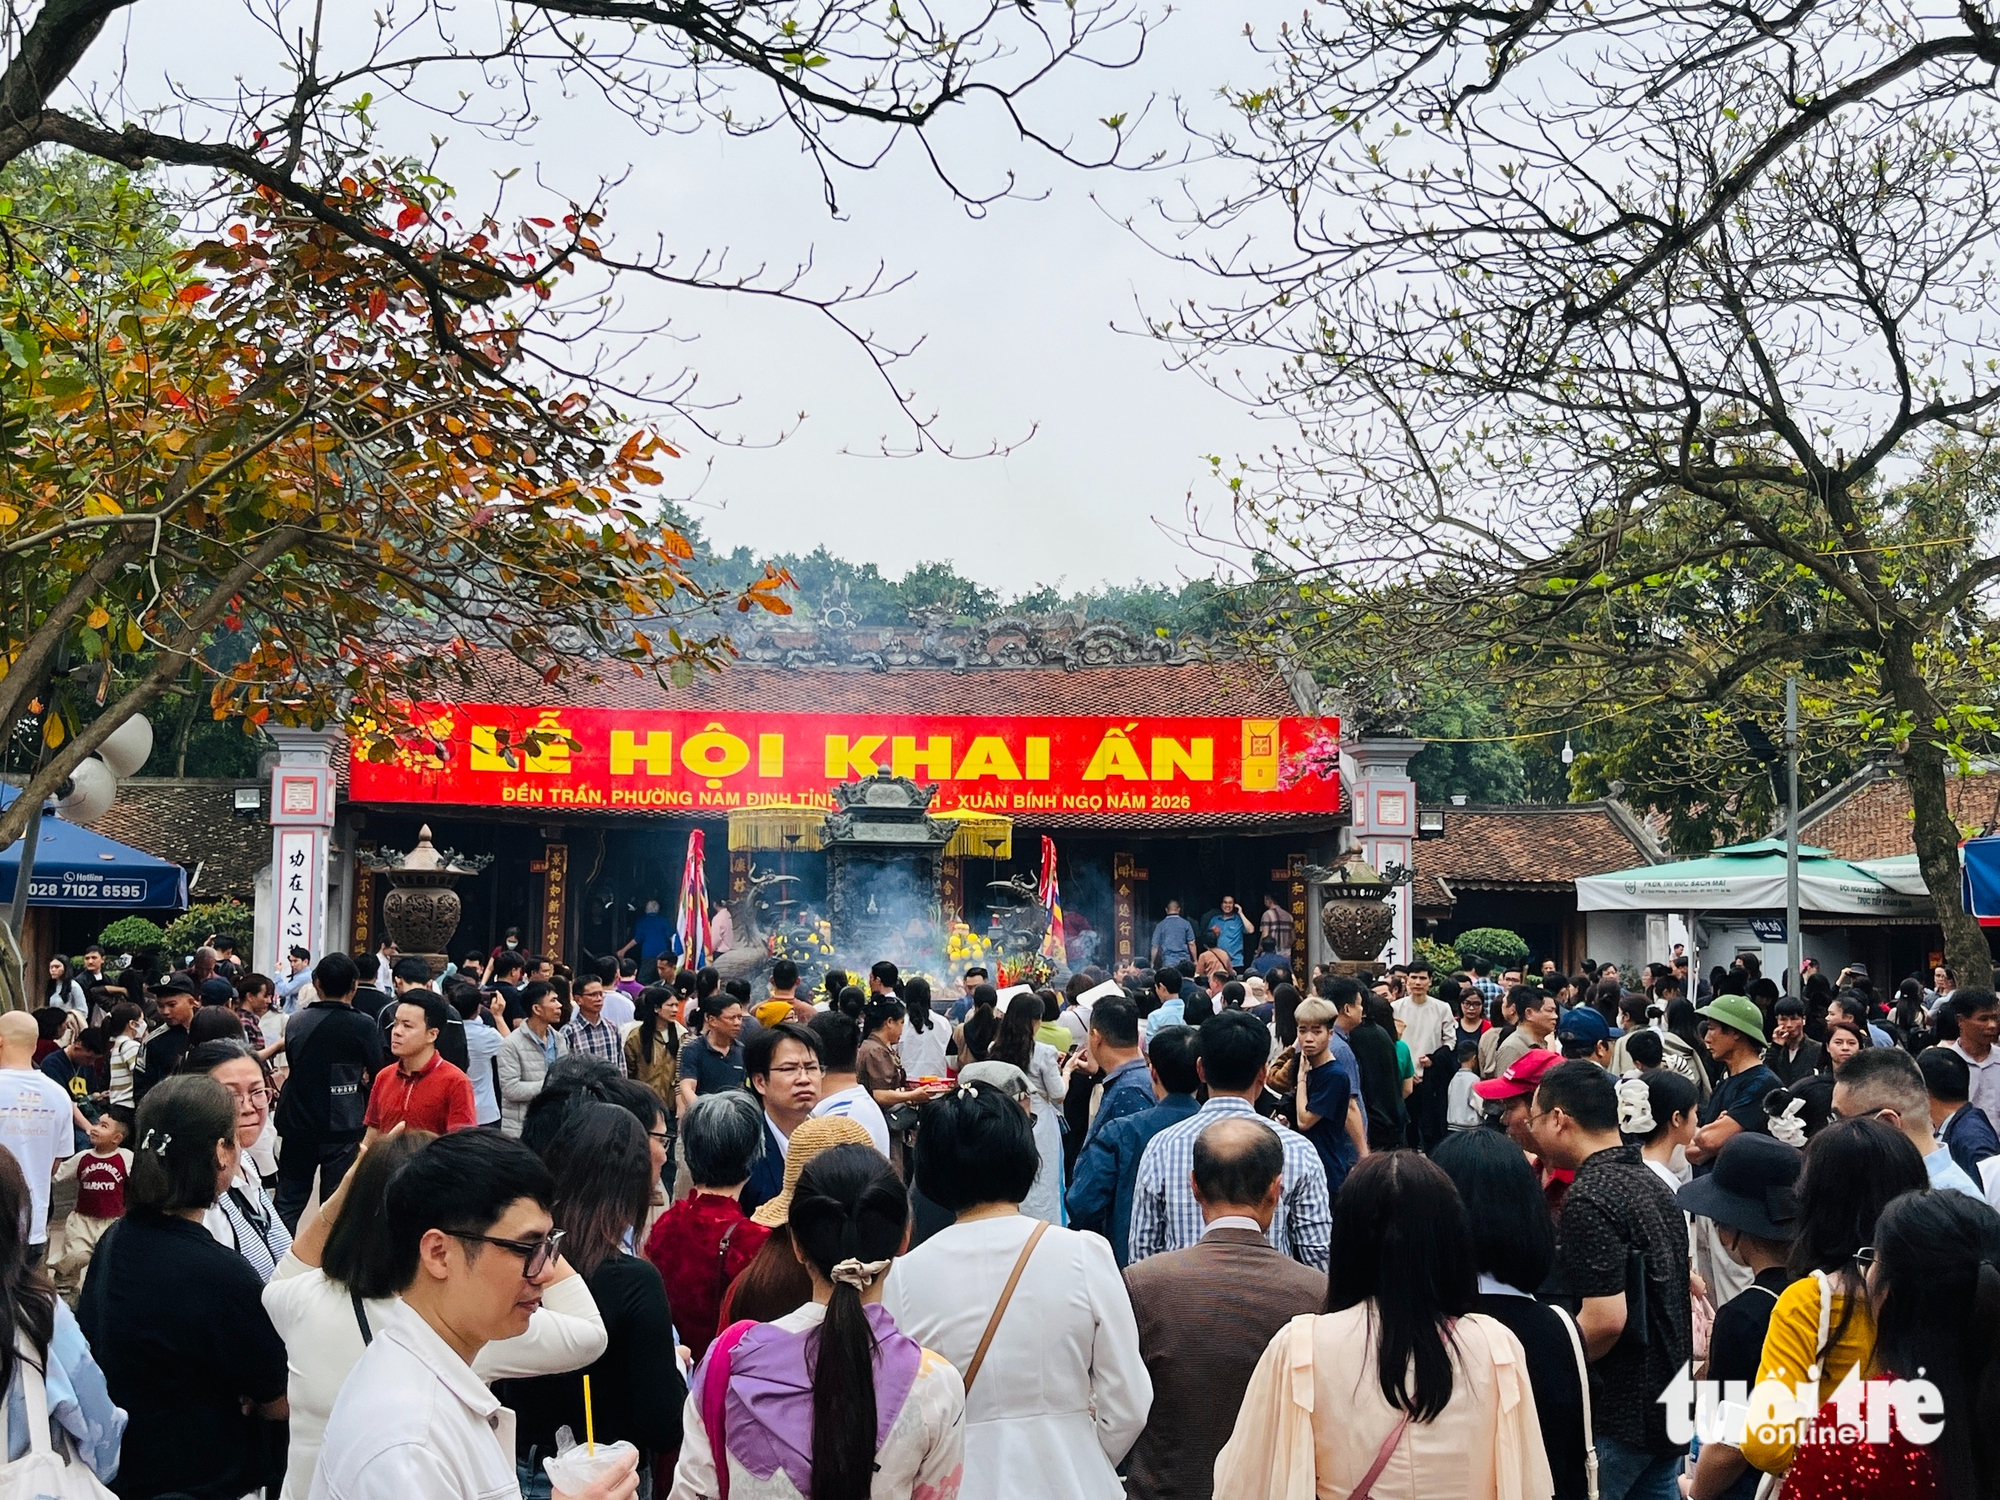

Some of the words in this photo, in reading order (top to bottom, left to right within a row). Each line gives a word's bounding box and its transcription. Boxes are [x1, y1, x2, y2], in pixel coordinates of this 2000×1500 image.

[471, 711, 572, 774] LỄ
[610, 722, 784, 789] HỘI
[825, 735, 1050, 780] KHAI
[1081, 722, 1214, 781] ẤN
[502, 783, 543, 803] ĐỀN
[549, 784, 607, 805] TRẦN,
[611, 787, 693, 806] PHƯỜNG
[699, 791, 740, 806] NAM
[958, 791, 1007, 809] XUÂN
[1013, 791, 1057, 809] BÍNH
[1063, 795, 1103, 811] NGỌ
[1107, 792, 1146, 809] NĂM
[1151, 795, 1191, 809] 2026
[76, 873, 104, 882] Hotline
[28, 883, 58, 896] 028
[62, 884, 98, 897] 7102
[102, 885, 140, 898] 6595
